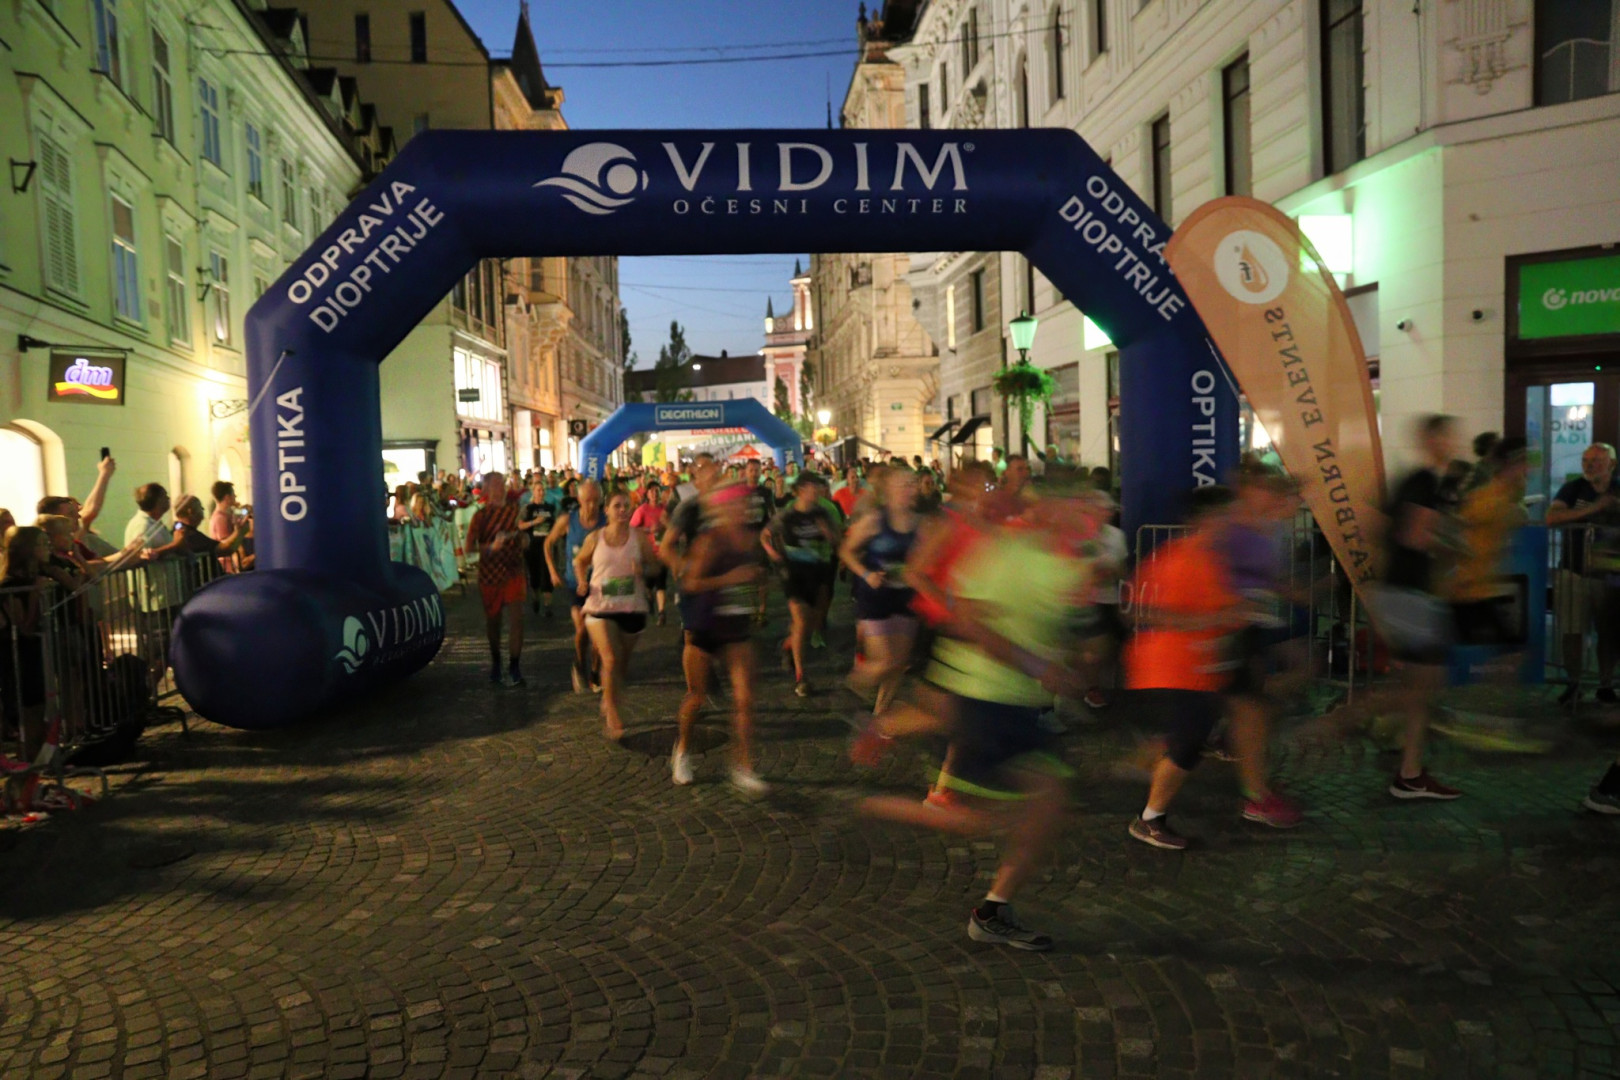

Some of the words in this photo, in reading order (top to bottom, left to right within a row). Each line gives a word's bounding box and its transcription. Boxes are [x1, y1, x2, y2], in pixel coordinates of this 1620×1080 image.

[288, 180, 416, 304] ODPRAVA
[308, 197, 445, 333] DIOPTRIJE
[673, 196, 807, 214] OČESNI
[834, 199, 967, 214] CENTER
[1058, 195, 1185, 321] DIOPTRIJE
[64, 357, 114, 387] dm
[660, 409, 720, 421] DECATHLON
[1191, 369, 1217, 489] OPTIKA
[276, 387, 308, 522] OPTIKA
[366, 593, 442, 649] VIDIM
